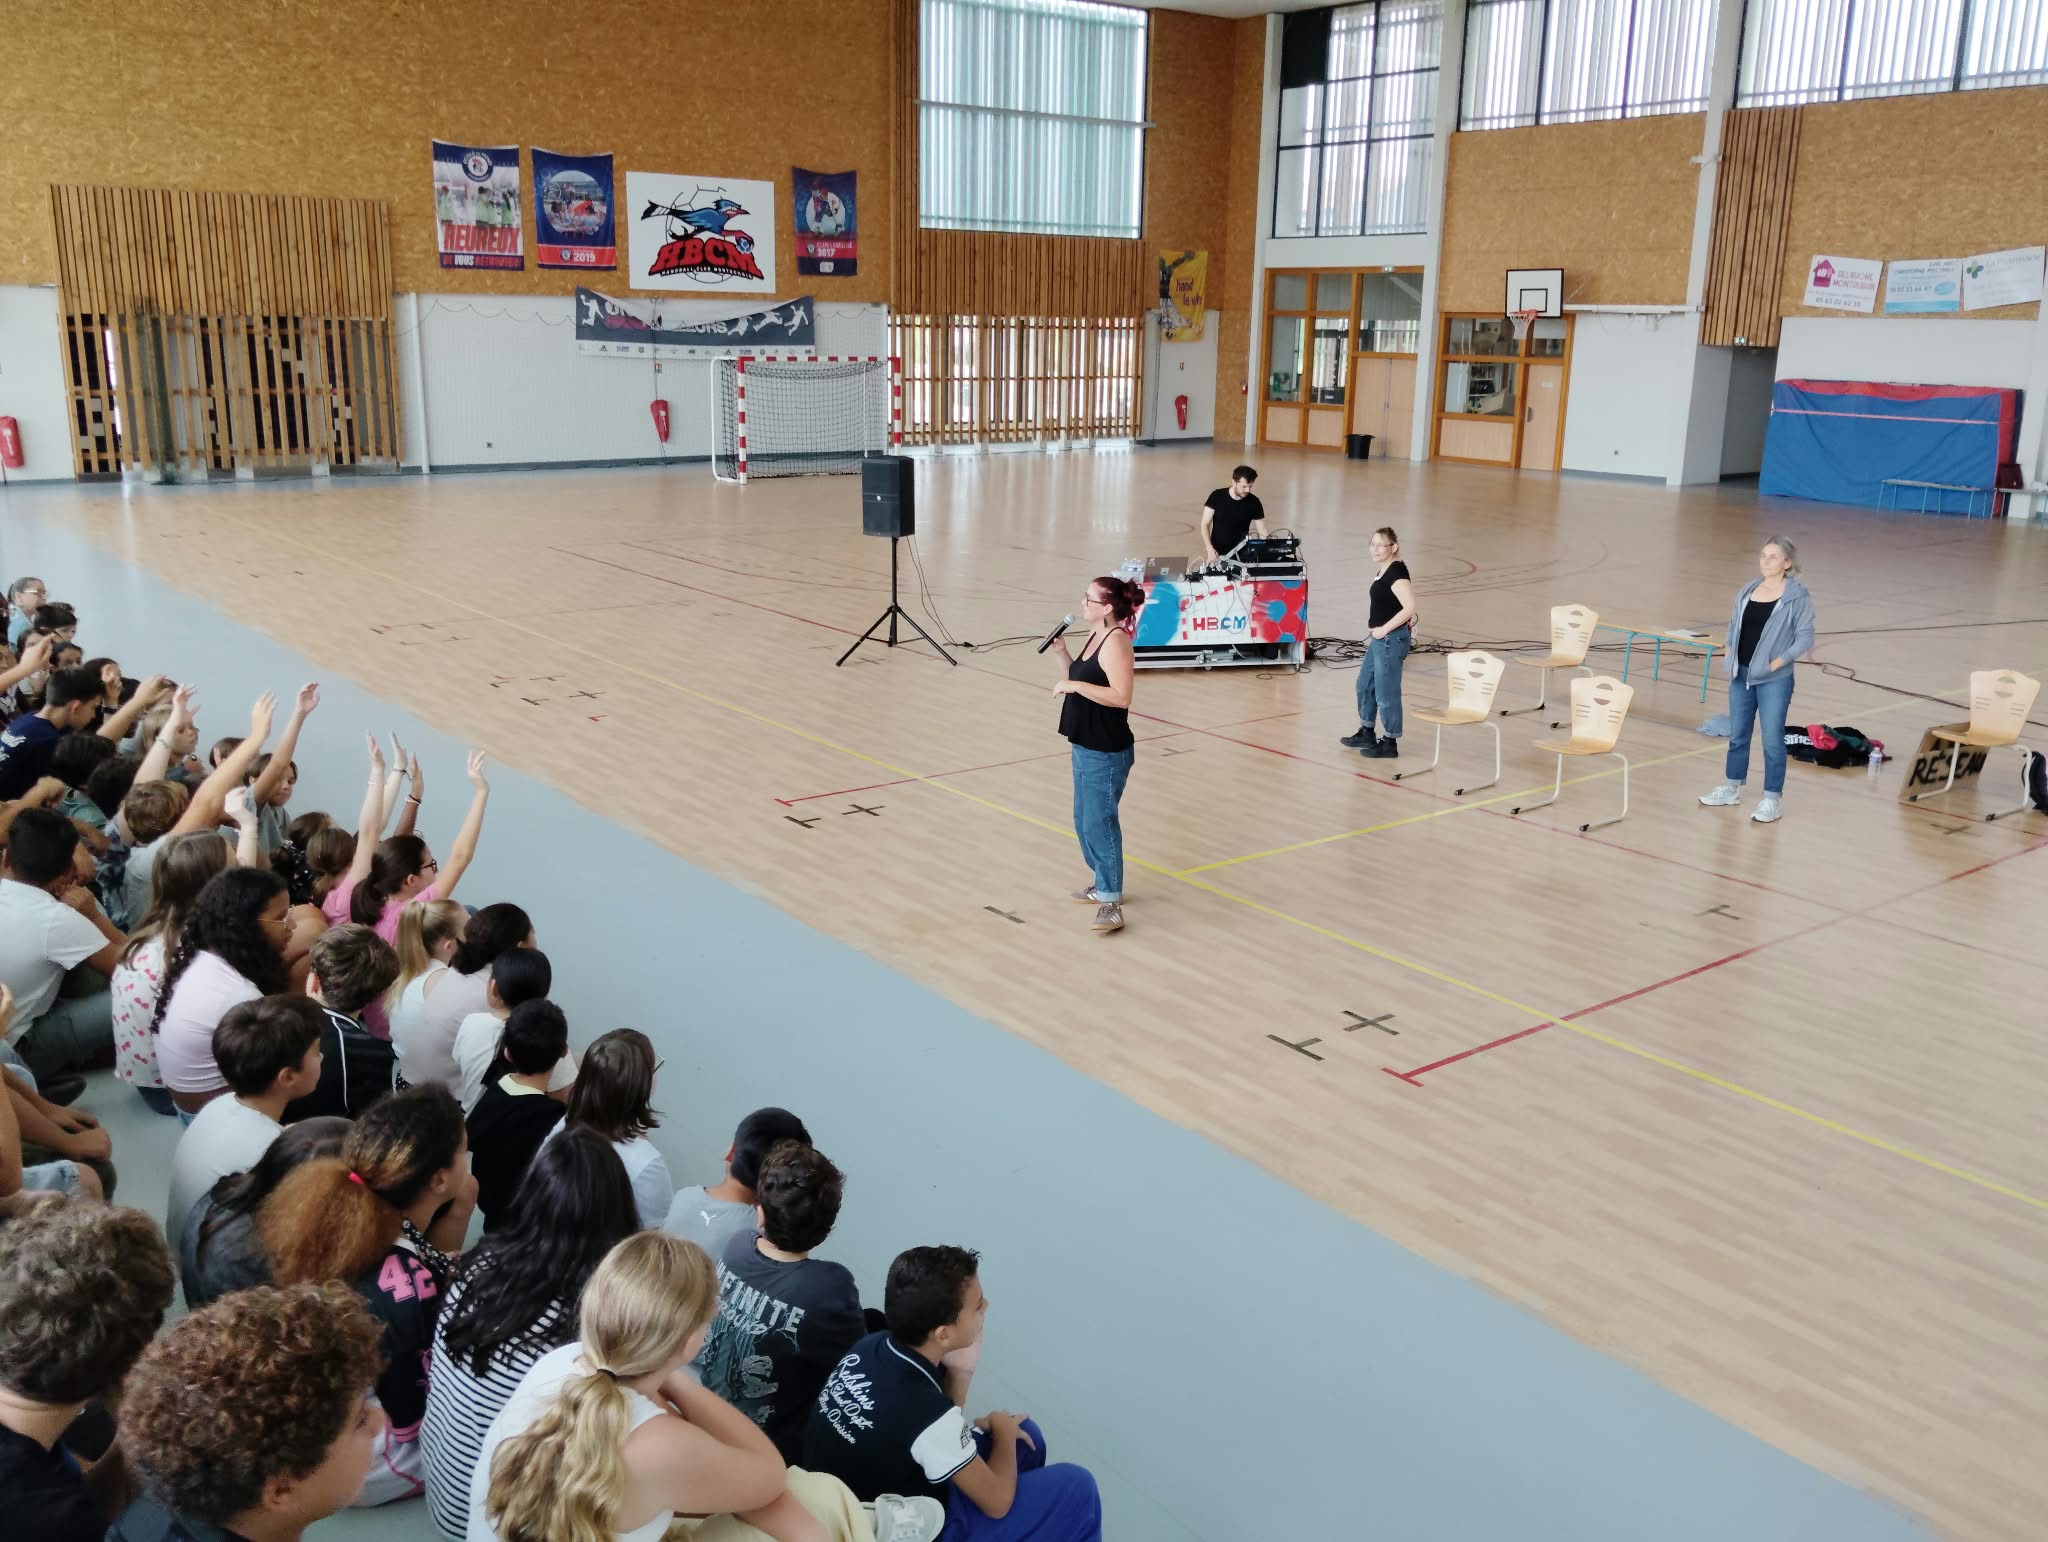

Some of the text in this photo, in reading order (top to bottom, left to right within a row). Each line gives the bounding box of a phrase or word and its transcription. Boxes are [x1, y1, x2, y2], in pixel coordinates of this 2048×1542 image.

[443, 223, 520, 254] HEUREUX
[454, 255, 475, 266] VOUS
[573, 252, 596, 263] 2019
[648, 237, 765, 280] HBCM
[817, 248, 836, 257] 2017
[661, 266, 695, 277] HANDBALL
[695, 265, 711, 273] CLUB
[1192, 615, 1247, 632] HBCM
[377, 1253, 438, 1303] 42
[837, 1353, 876, 1411] Redskins
[827, 1408, 858, 1444] Division
